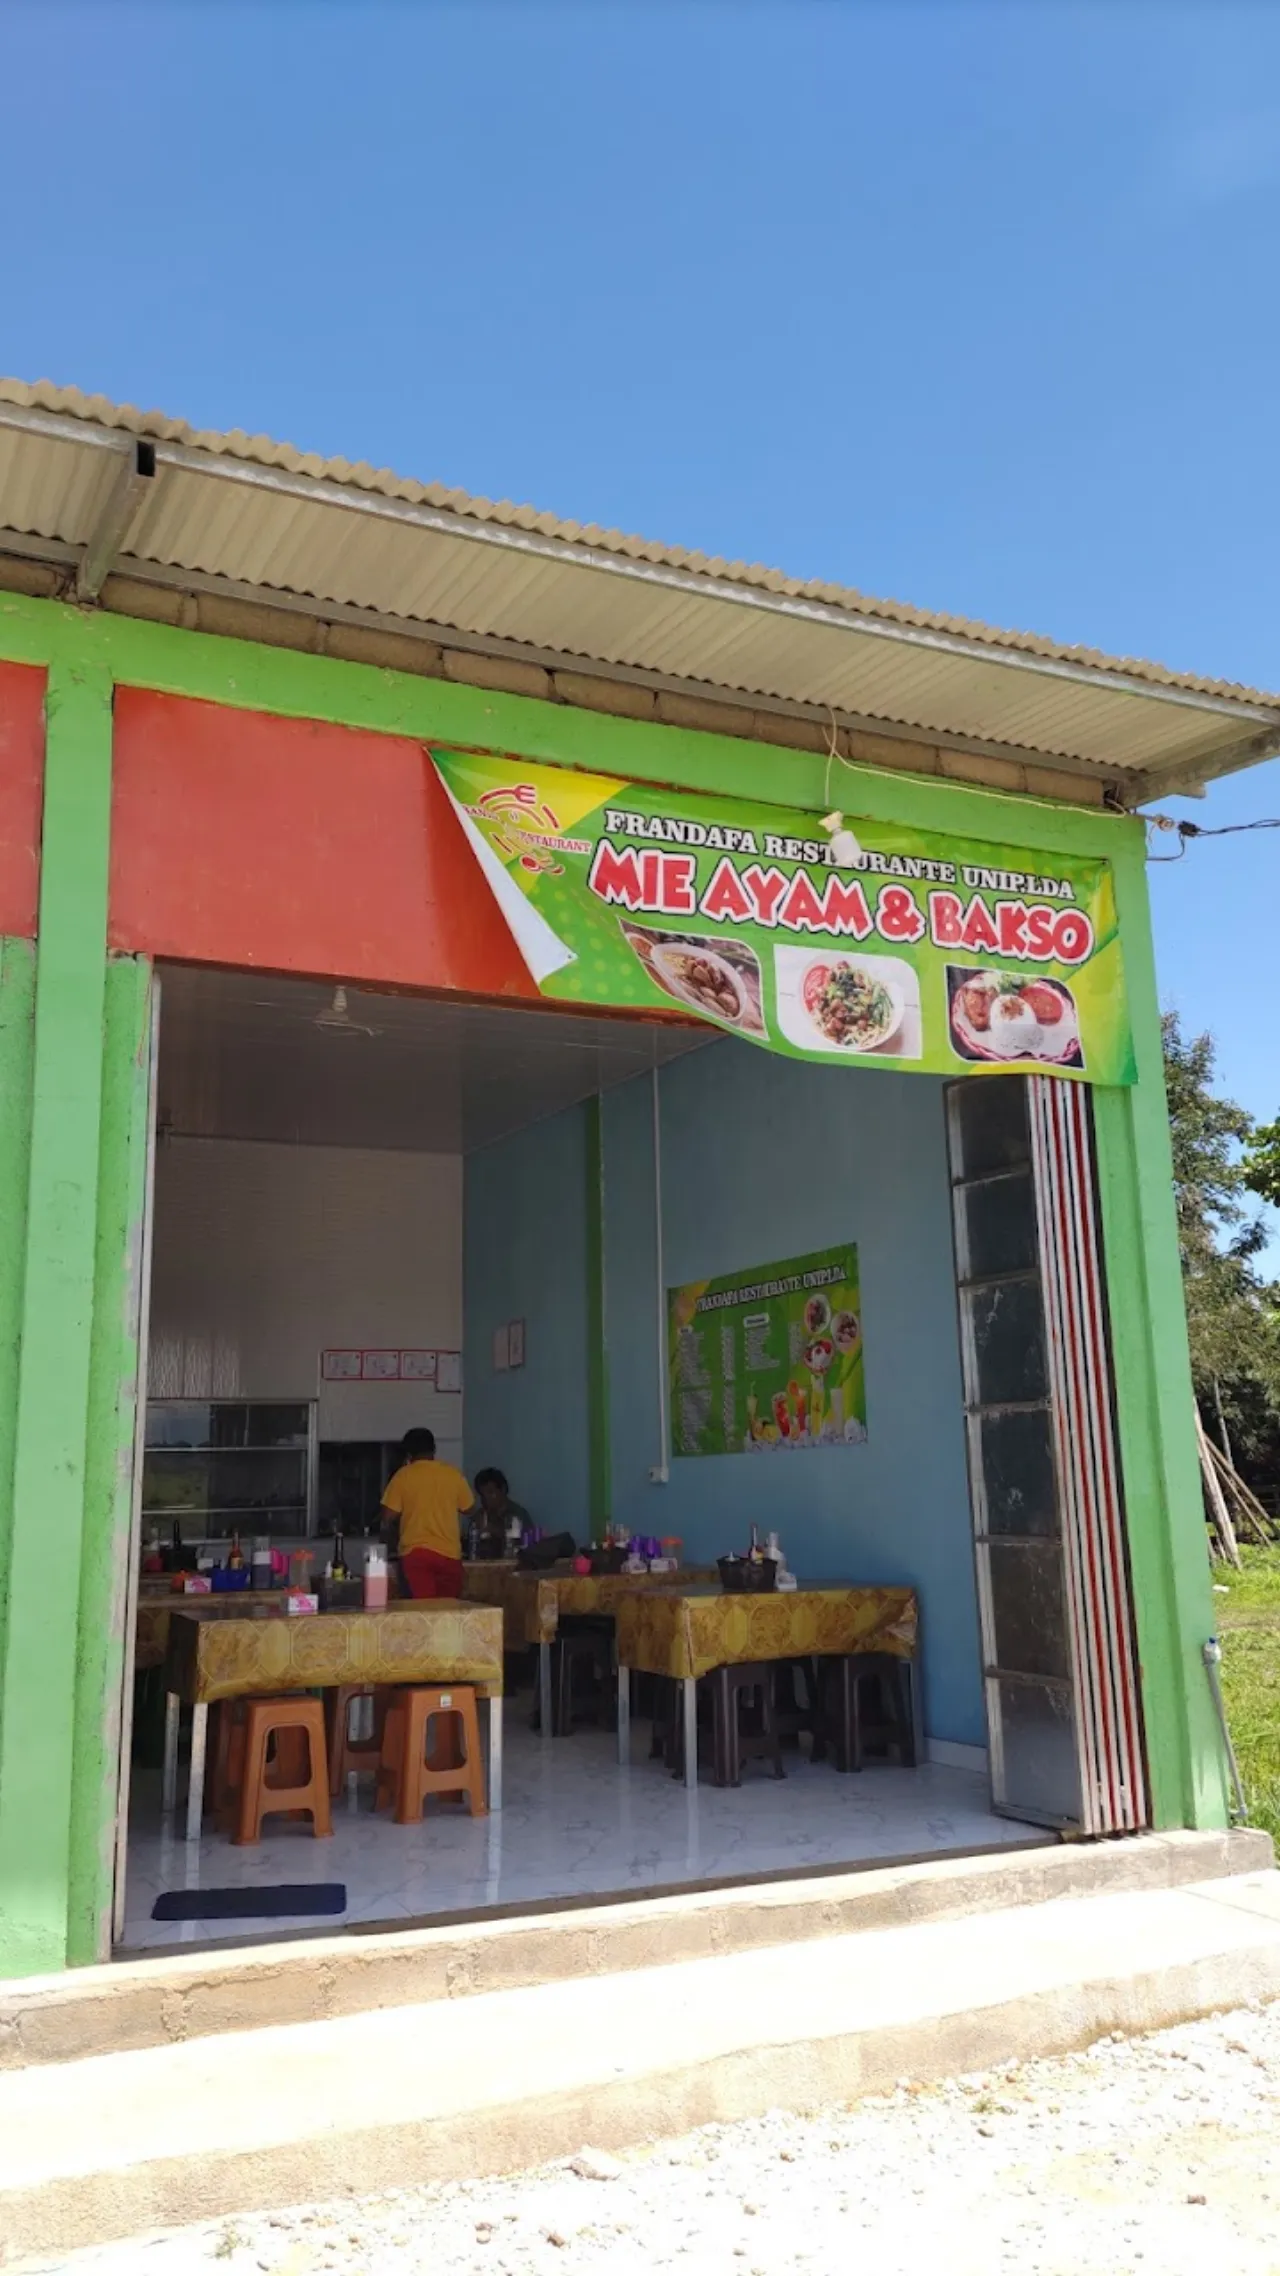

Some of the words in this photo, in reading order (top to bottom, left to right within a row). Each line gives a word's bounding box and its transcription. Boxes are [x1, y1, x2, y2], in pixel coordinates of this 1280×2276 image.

[604, 809, 758, 855] FRANDAFA
[764, 833, 956, 883] RESTURANTE
[588, 838, 697, 916] MIE
[700, 855, 874, 942] AYAM
[876, 882, 926, 943] &
[928, 889, 1095, 966] BAKSO
